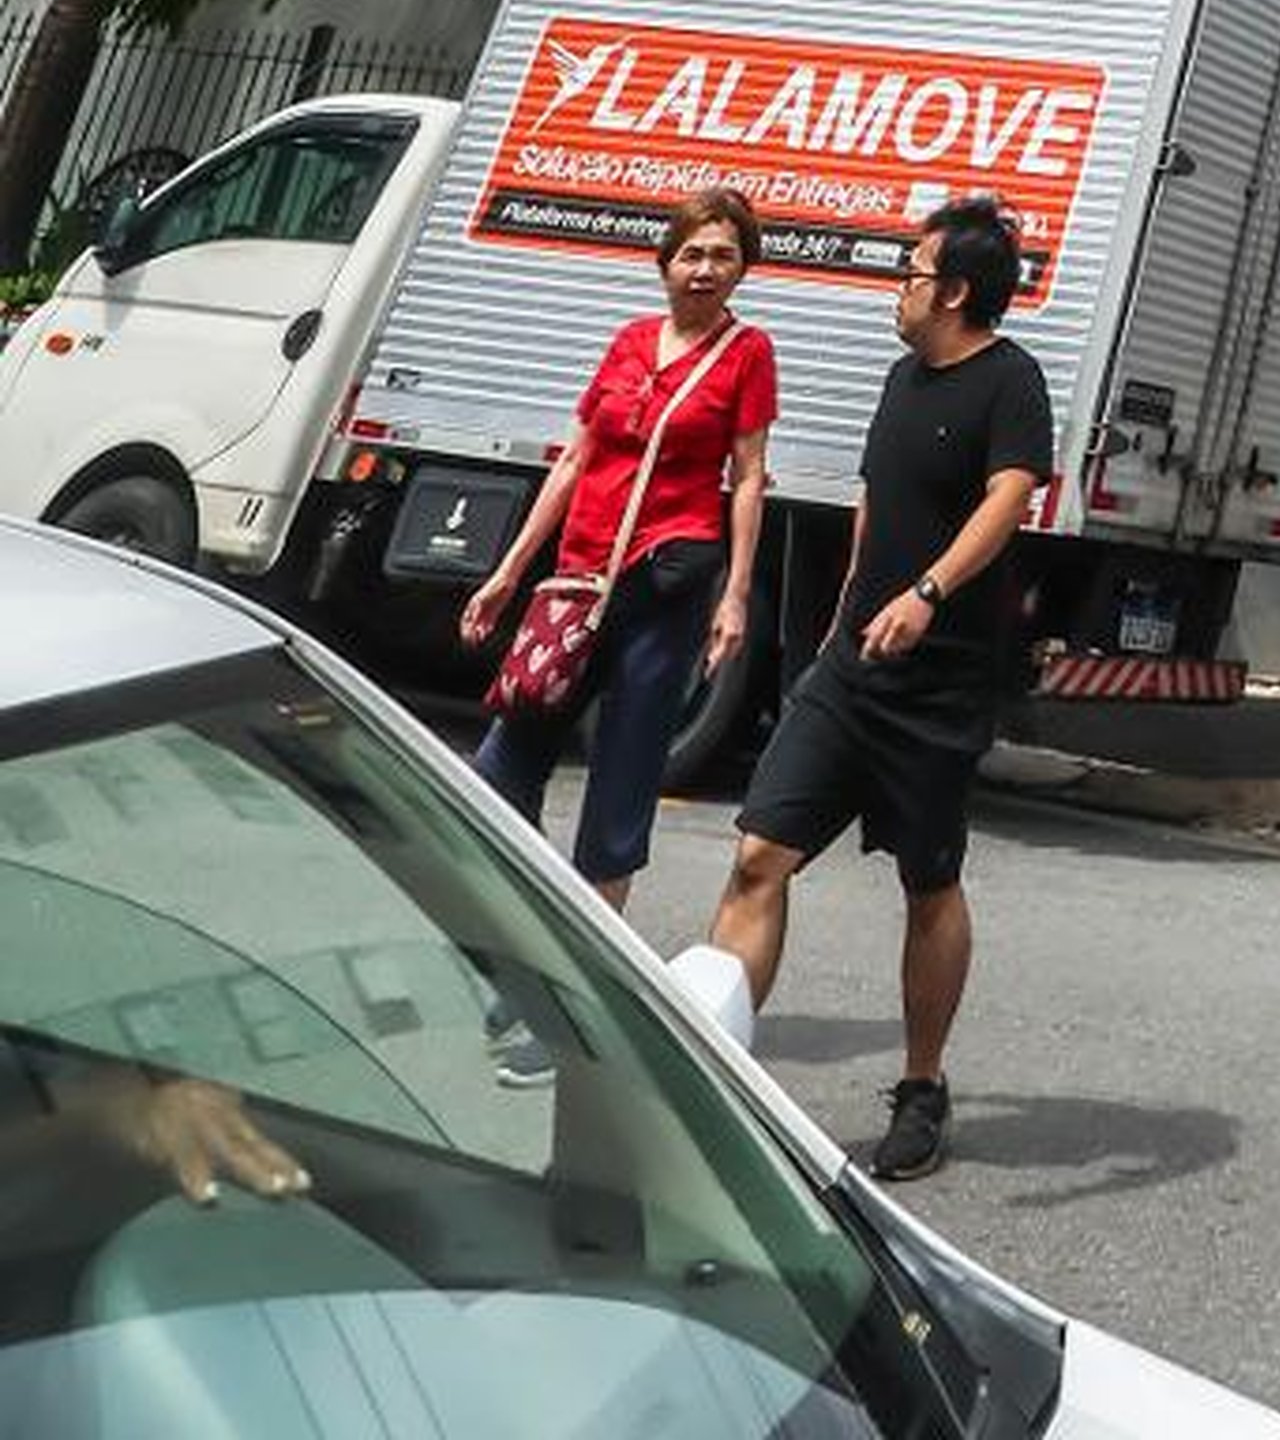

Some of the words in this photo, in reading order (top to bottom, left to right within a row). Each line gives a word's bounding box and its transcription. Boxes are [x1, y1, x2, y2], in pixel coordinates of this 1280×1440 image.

[588, 46, 1093, 178] LALAMOVE
[501, 201, 591, 230] Plataforma
[513, 143, 622, 183] Solução
[768, 171, 894, 218] Entregas
